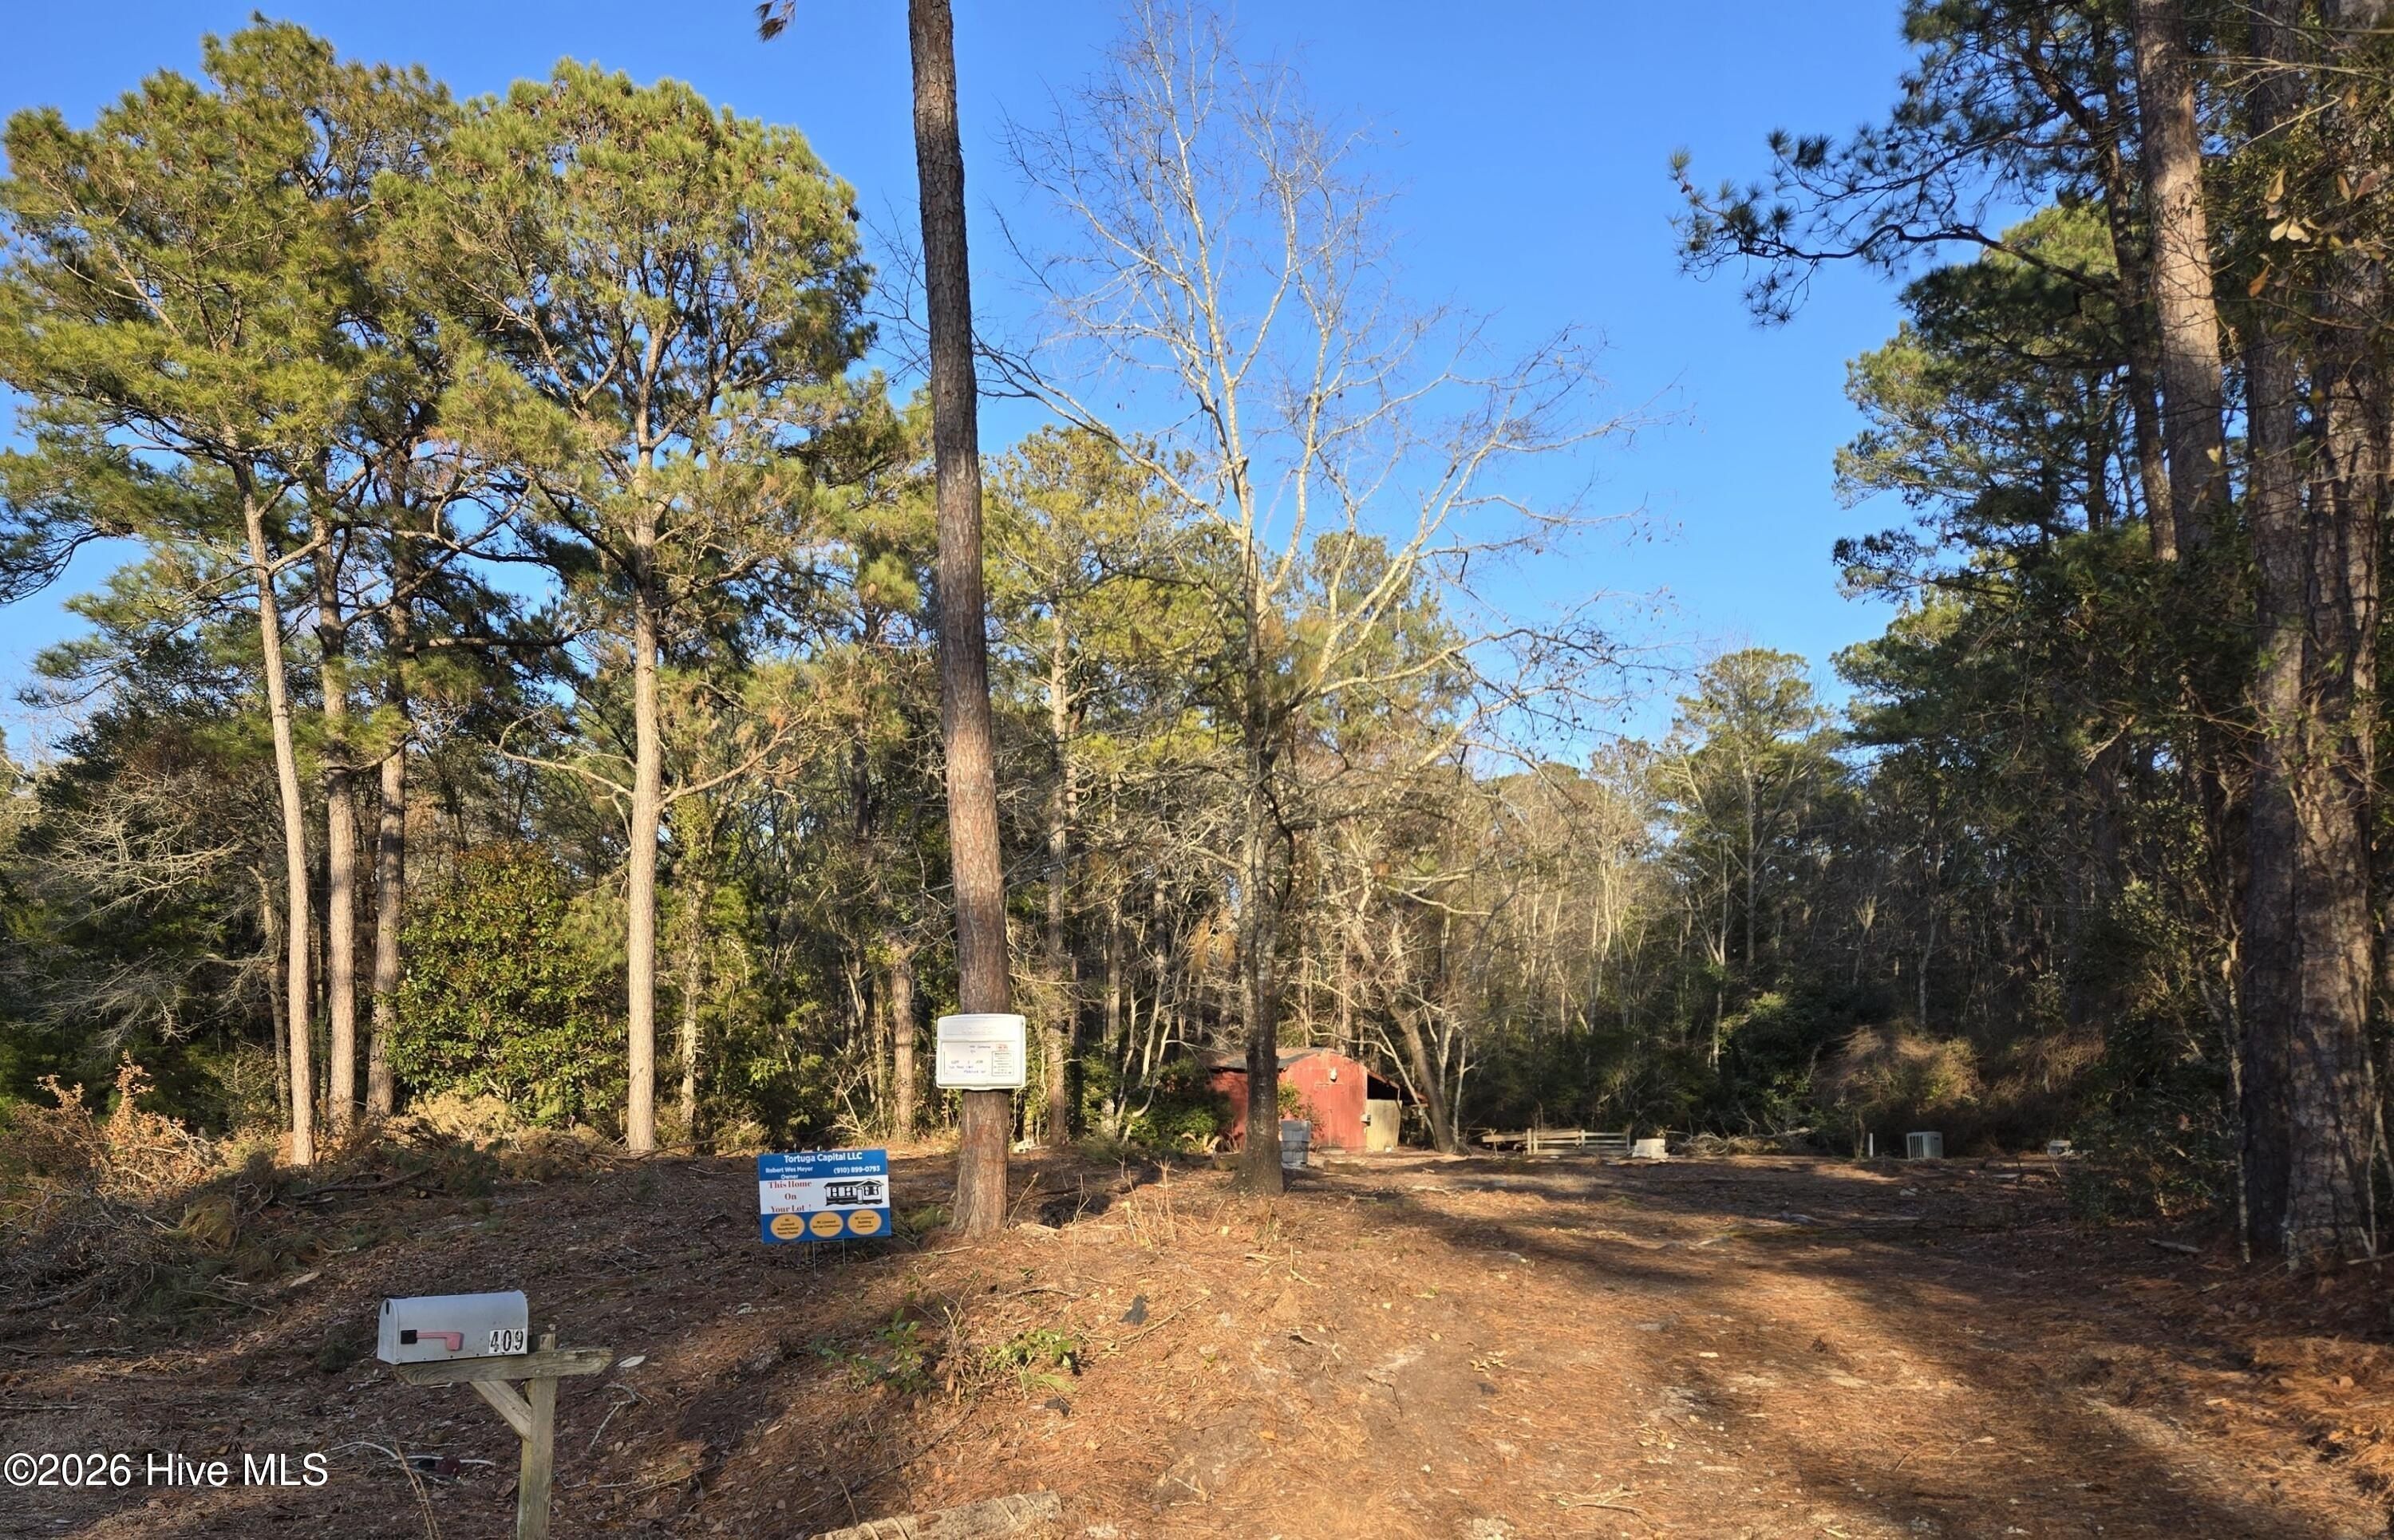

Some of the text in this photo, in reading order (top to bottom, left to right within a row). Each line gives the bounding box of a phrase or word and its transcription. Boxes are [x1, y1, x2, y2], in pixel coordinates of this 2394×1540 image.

[784, 1151, 863, 1163] Tortuga Capital LLC
[490, 1329, 524, 1352] 409
